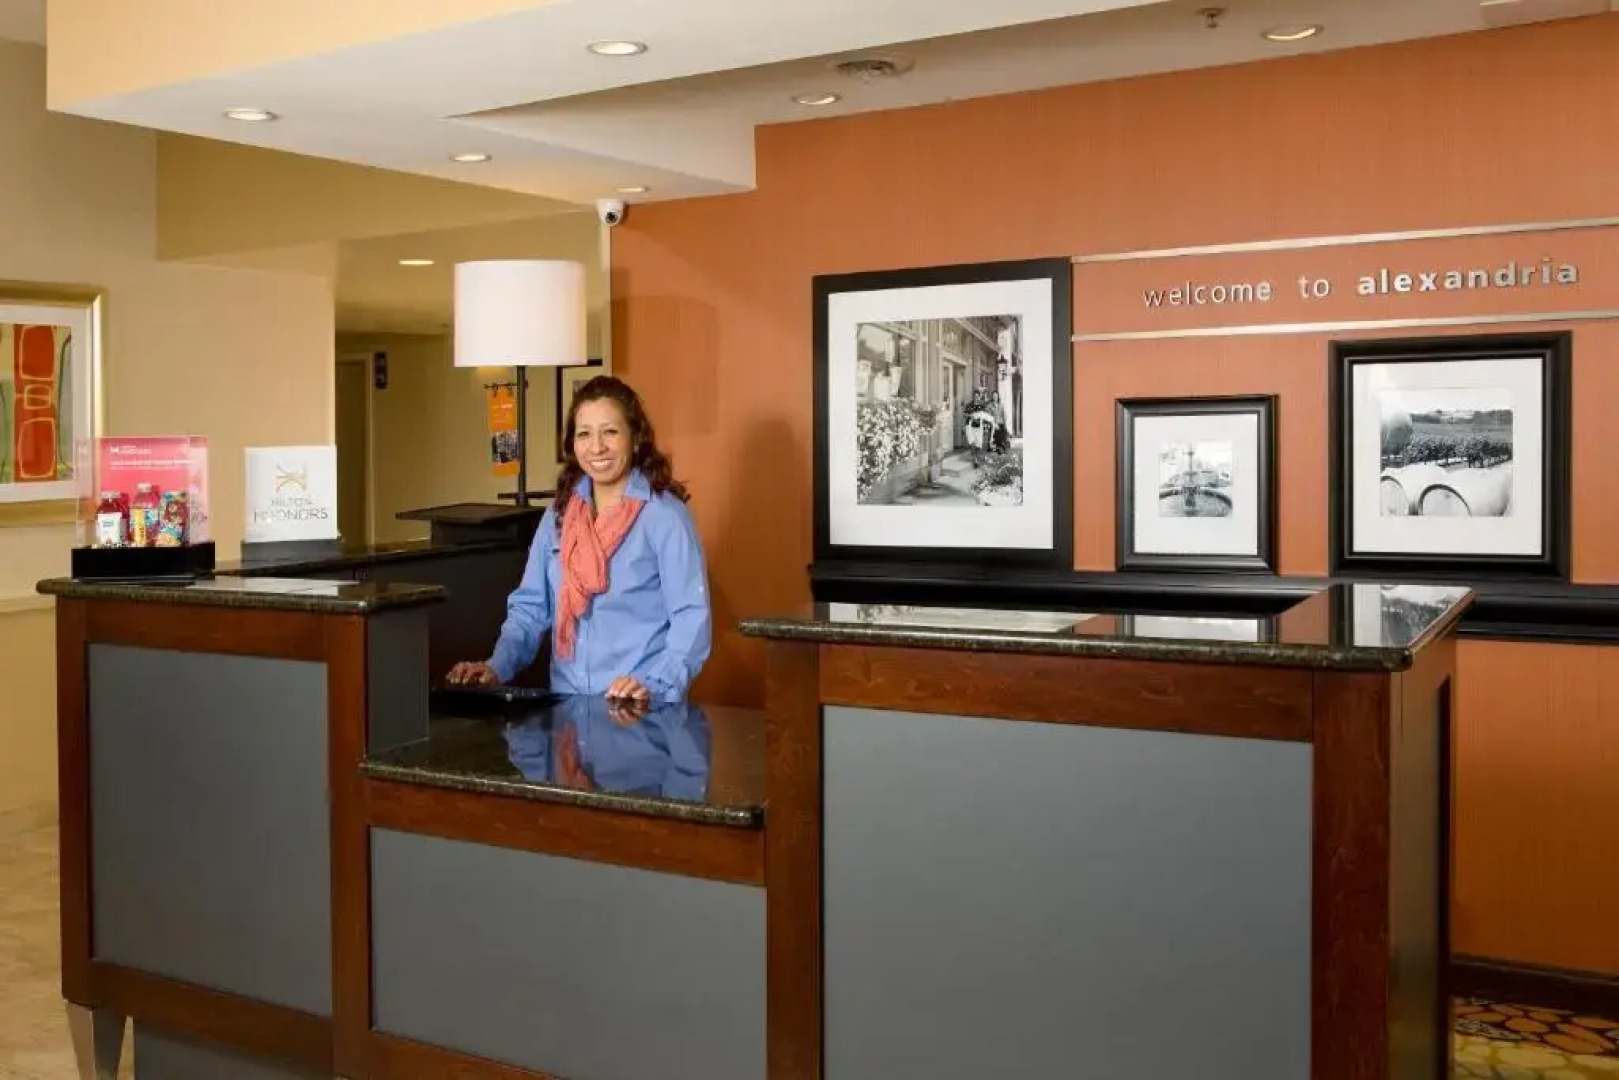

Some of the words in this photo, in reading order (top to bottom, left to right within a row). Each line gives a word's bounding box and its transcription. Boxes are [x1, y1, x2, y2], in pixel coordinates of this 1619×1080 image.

[1143, 275, 1272, 307] welcome
[1298, 274, 1331, 299] to
[1356, 256, 1580, 296] alexandria
